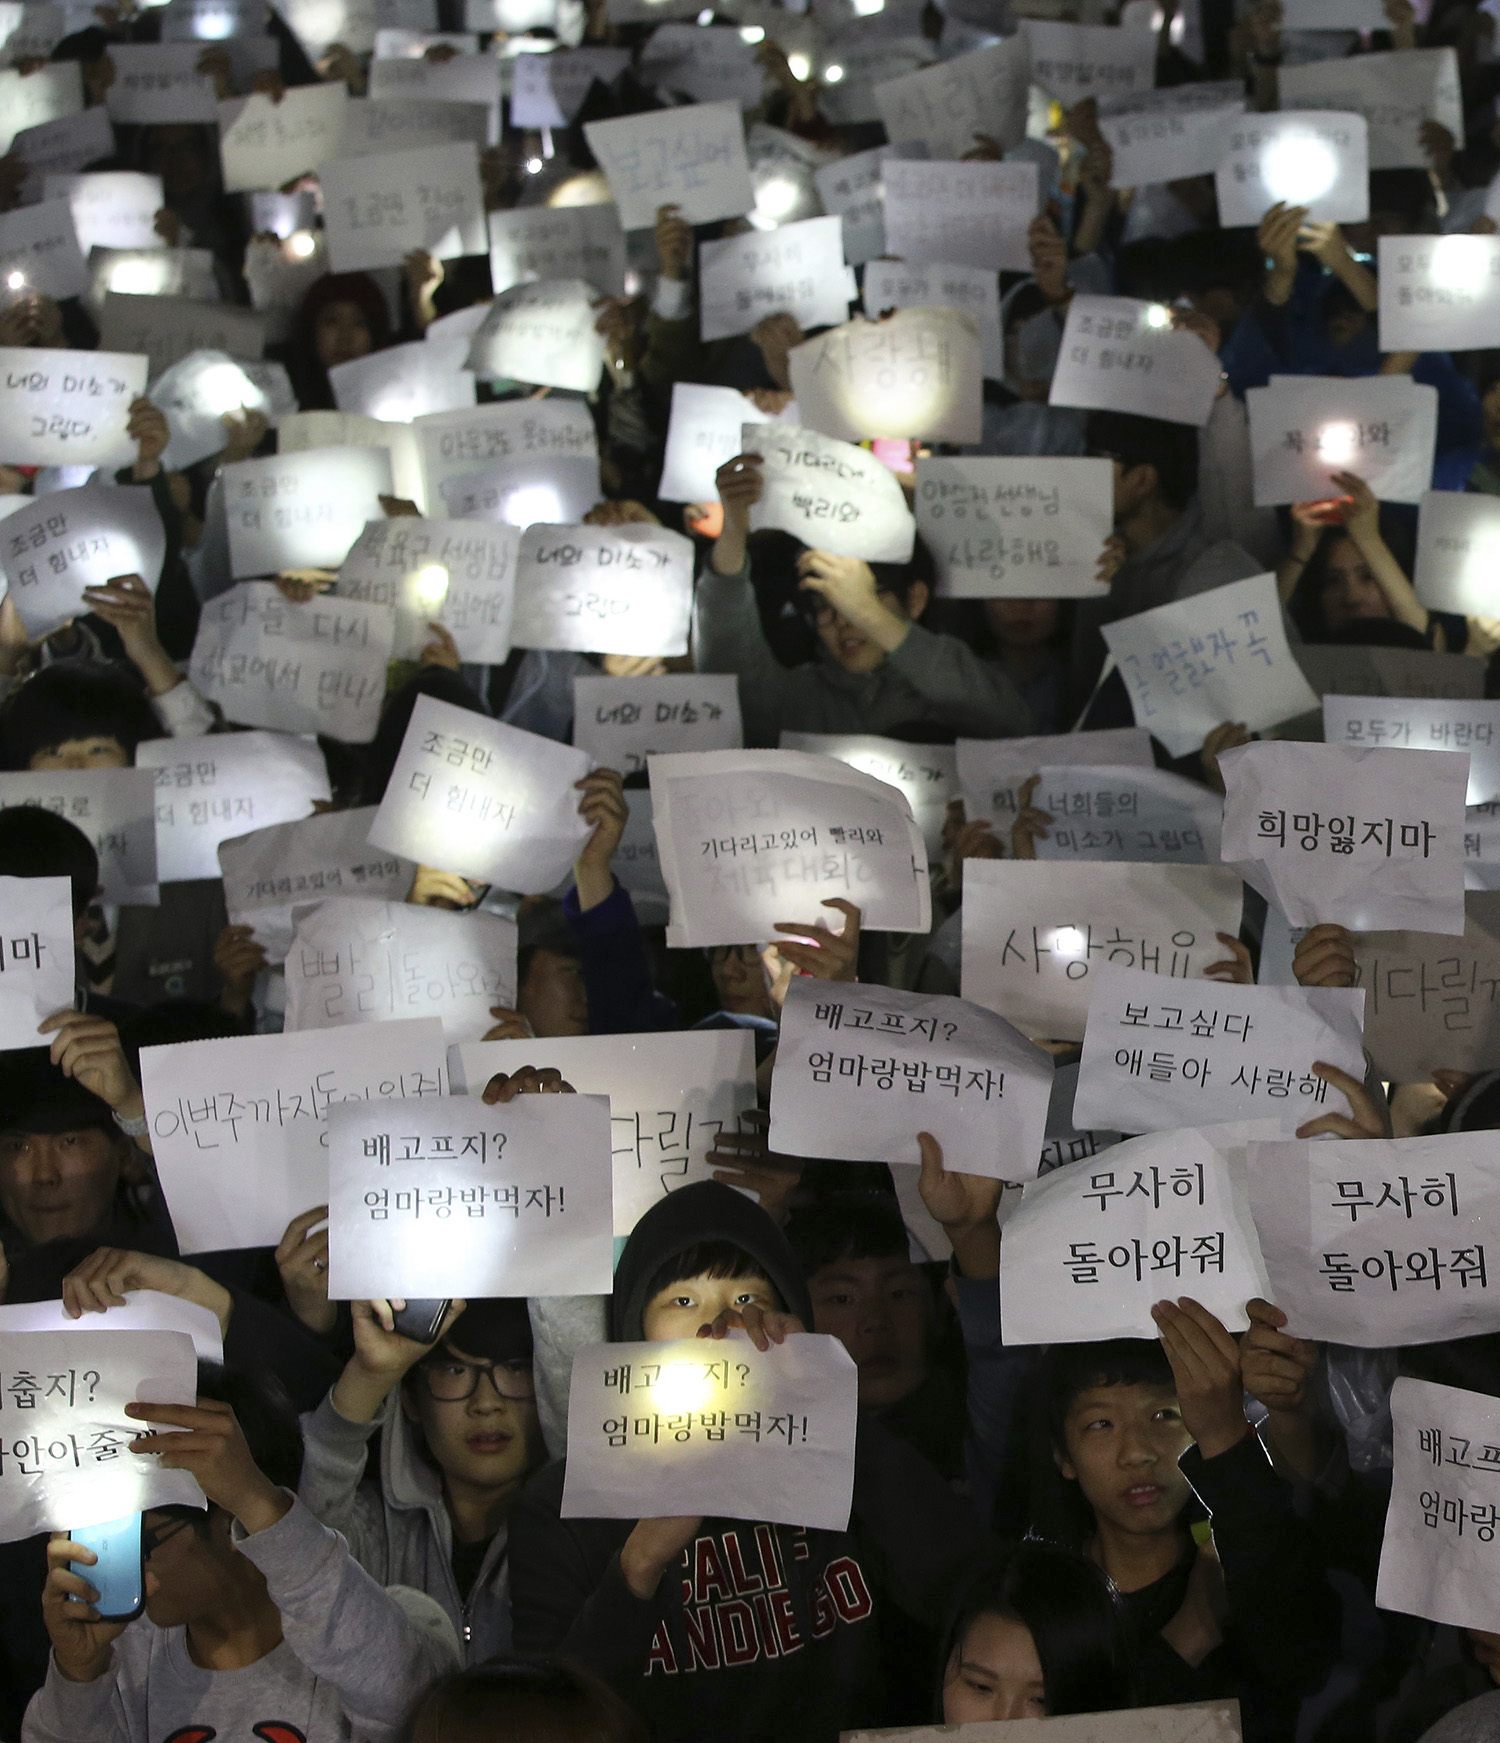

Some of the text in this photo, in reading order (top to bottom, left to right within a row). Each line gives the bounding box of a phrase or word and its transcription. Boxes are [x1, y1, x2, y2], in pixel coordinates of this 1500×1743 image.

[420, 729, 496, 777] 조금만
[1343, 718, 1495, 747] 모두가 바란다
[408, 770, 433, 802] 더
[699, 825, 886, 860] 기다리고있어 빨리와
[1256, 808, 1437, 860] 희망잃지마
[813, 1001, 960, 1044] 배고프지?
[1118, 1002, 1255, 1044] 보고싶다
[807, 1051, 1006, 1101] 엄마랑밥먹자!
[1113, 1046, 1330, 1105] 애들아 사랑해
[361, 1129, 509, 1168] 배고프지?
[363, 1184, 566, 1222] 엄마랑밥먹자!
[1081, 1162, 1207, 1213] 무사히
[1330, 1172, 1461, 1223] 무사히
[1062, 1230, 1228, 1286] 돌아와줘
[1318, 1244, 1489, 1293] 돌아와줘
[0, 1368, 103, 1411] 춥지?
[602, 1357, 753, 1396] 배고지?
[601, 1409, 810, 1450] 엄마랑밥먹자!
